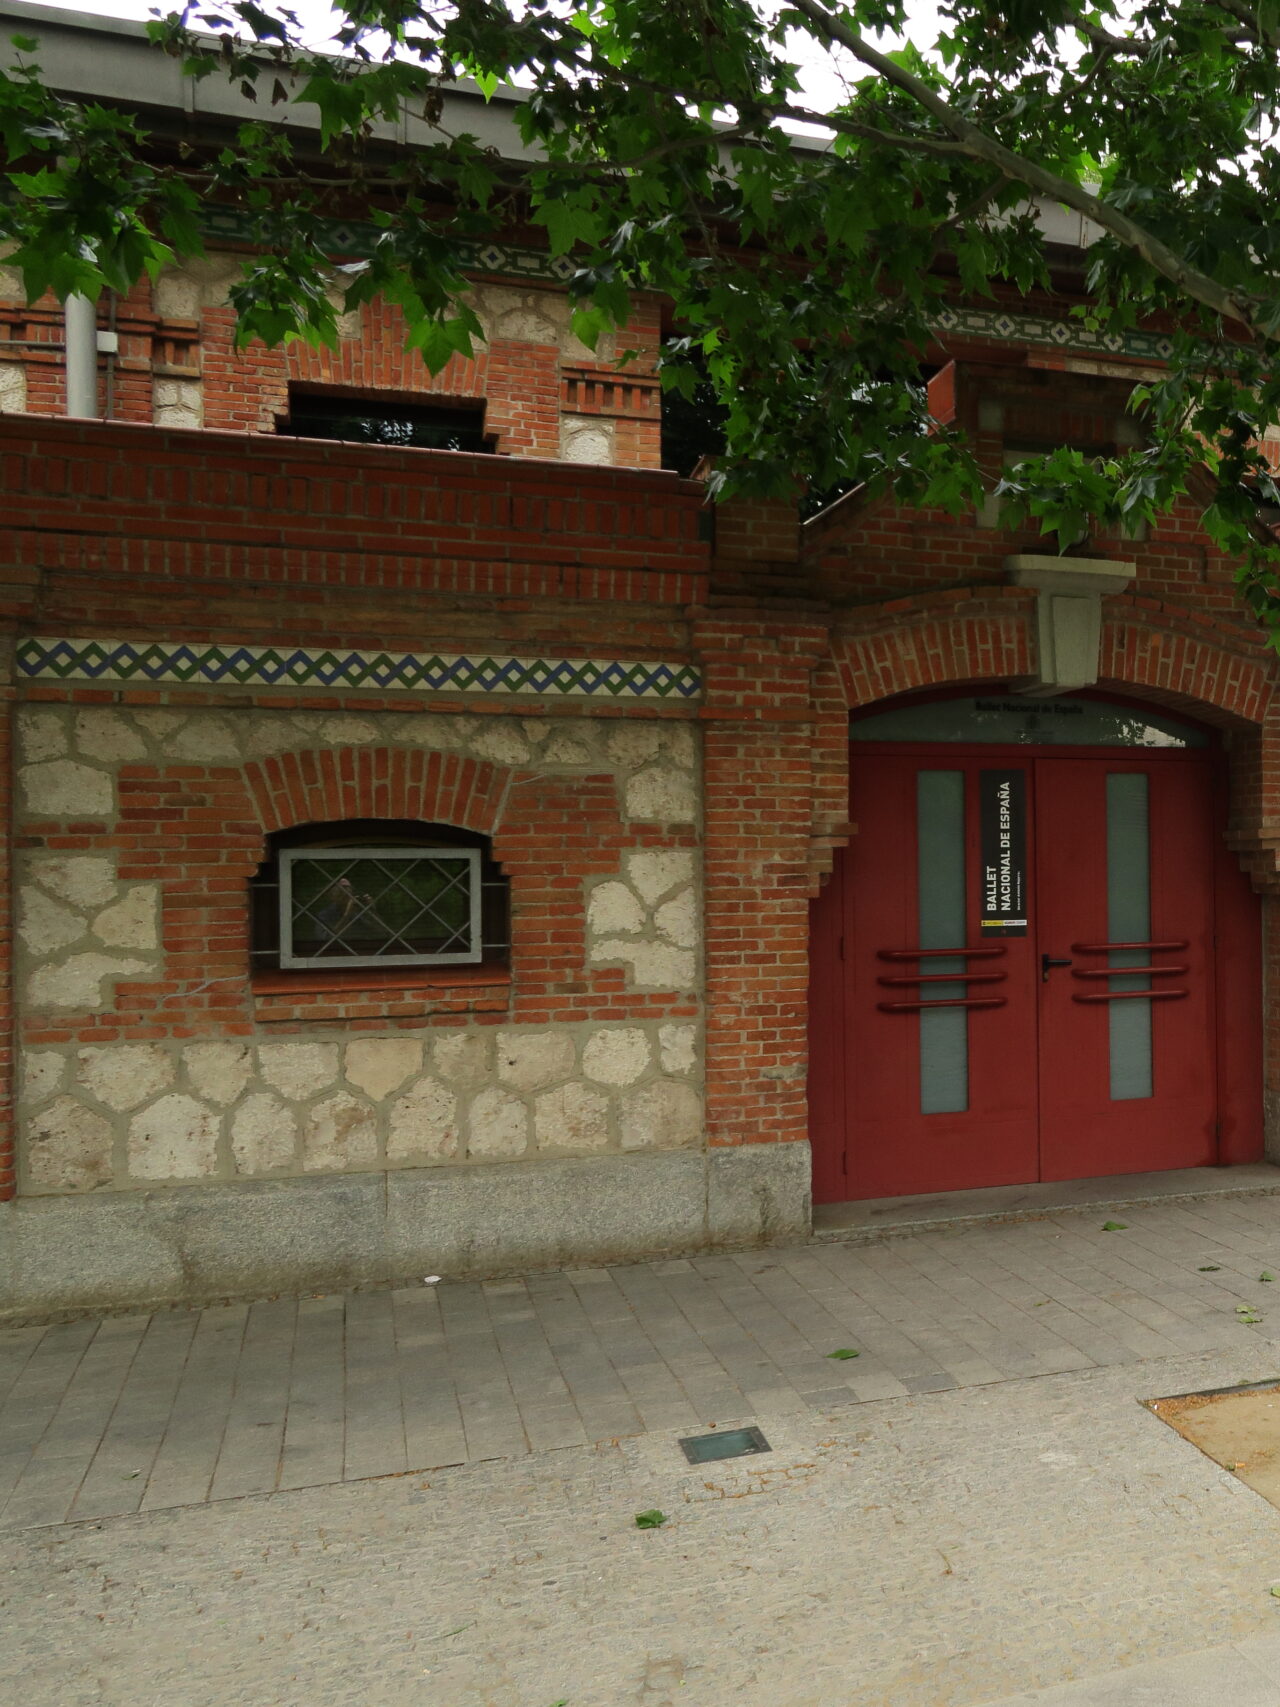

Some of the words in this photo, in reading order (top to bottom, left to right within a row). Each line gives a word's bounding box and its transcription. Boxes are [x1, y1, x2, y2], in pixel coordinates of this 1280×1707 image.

[997, 782, 1010, 829] ESPAÑA
[1000, 832, 1011, 848] DE
[986, 865, 997, 911] BALLET
[1000, 850, 1011, 911] NACIONAL
